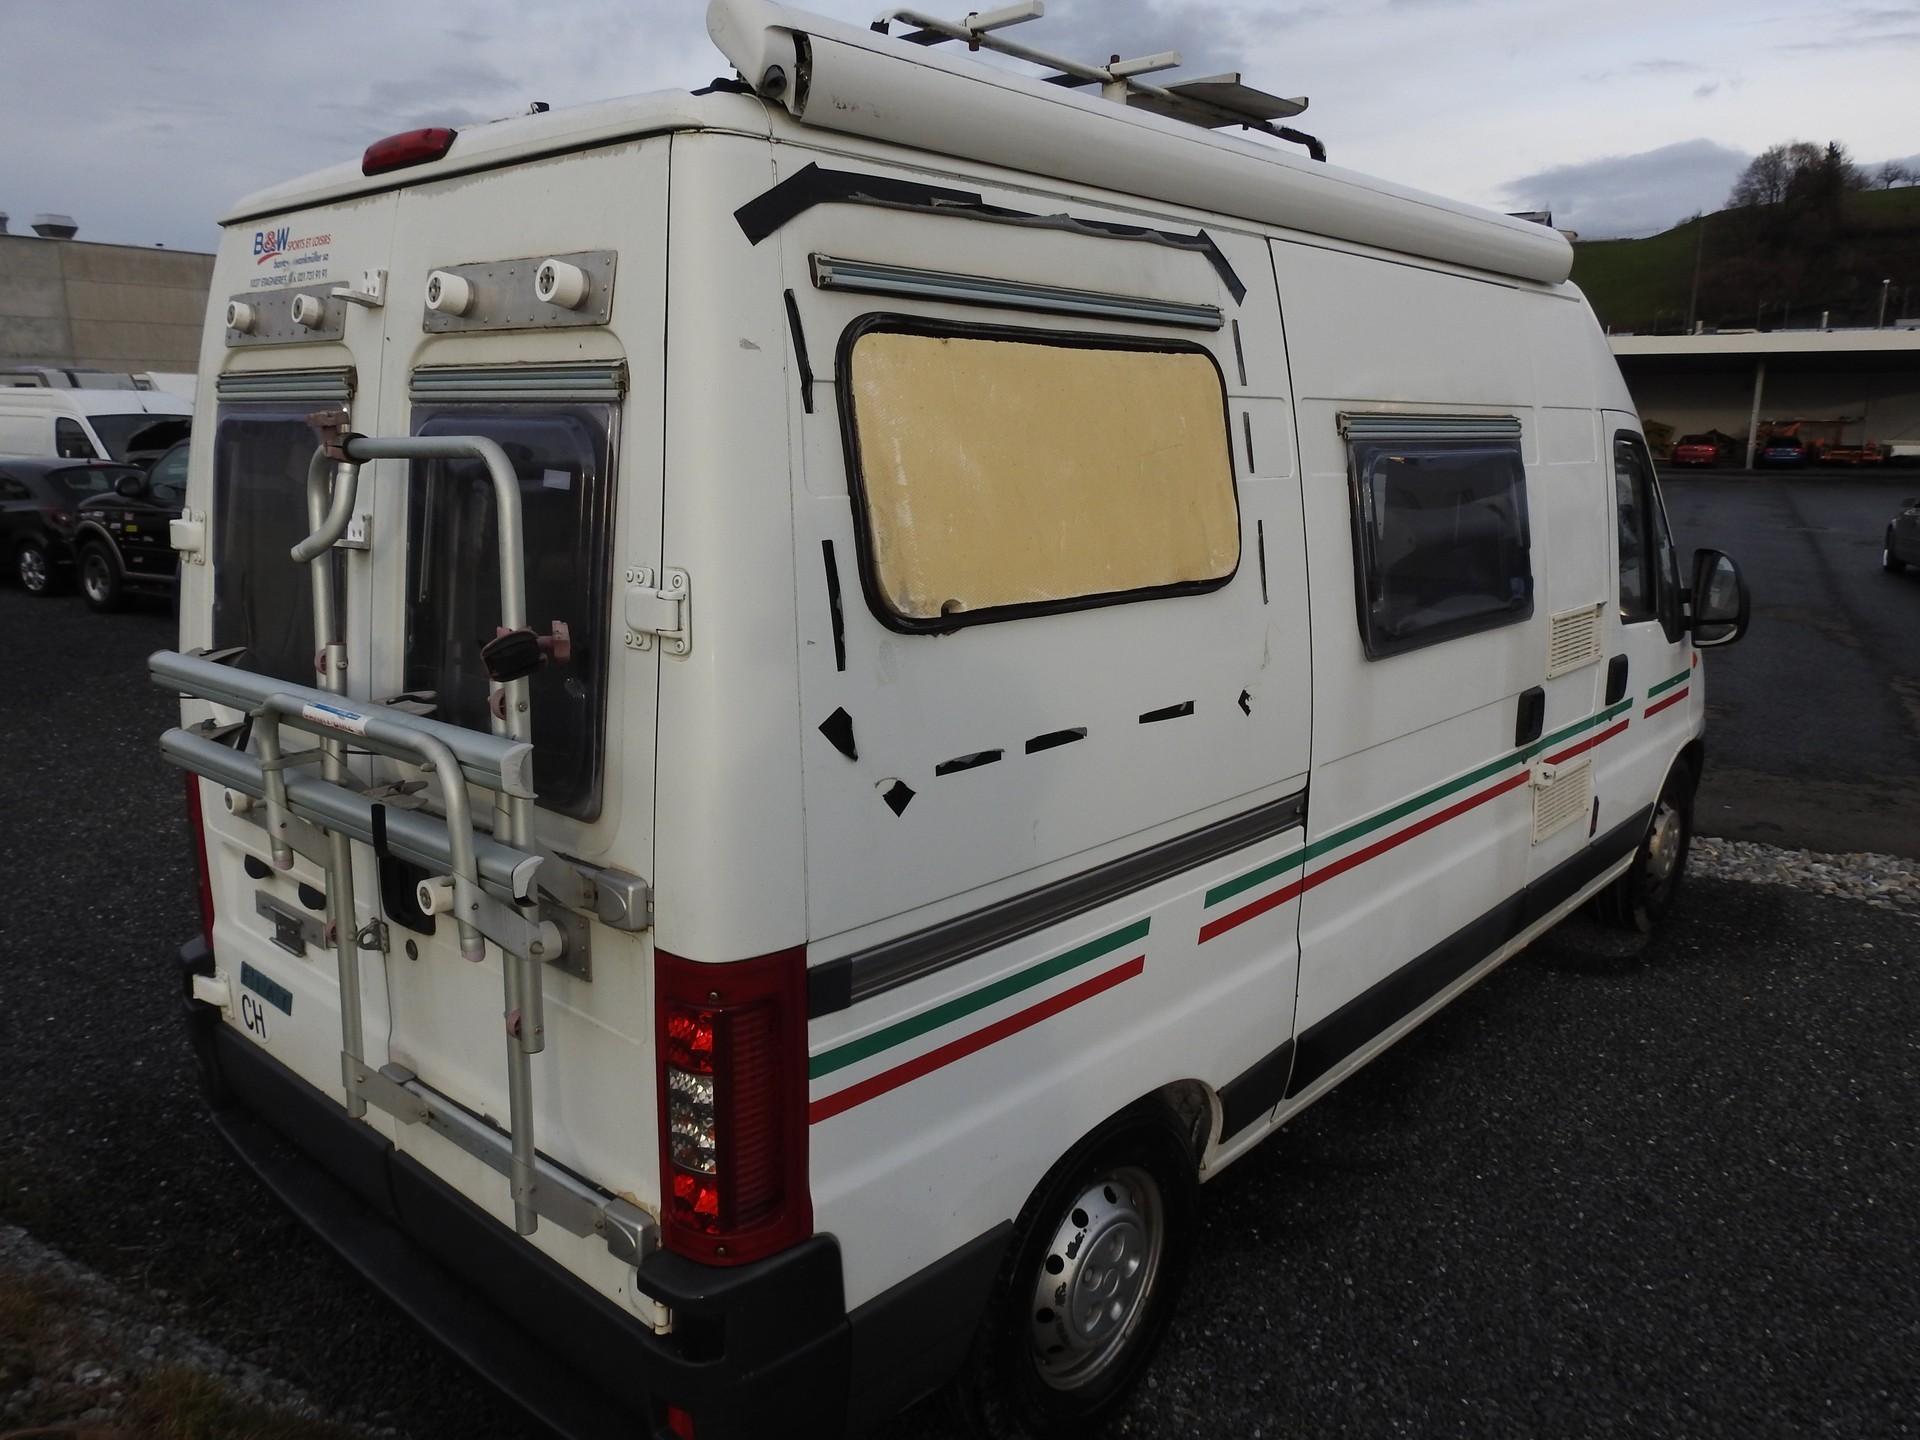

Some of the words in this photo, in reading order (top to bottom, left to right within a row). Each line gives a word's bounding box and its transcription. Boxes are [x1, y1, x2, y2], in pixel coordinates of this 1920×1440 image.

[253, 227, 290, 256] B&W
[287, 238, 305, 251] SPORTS
[306, 237, 312, 248] ET
[242, 994, 266, 1038] CH
